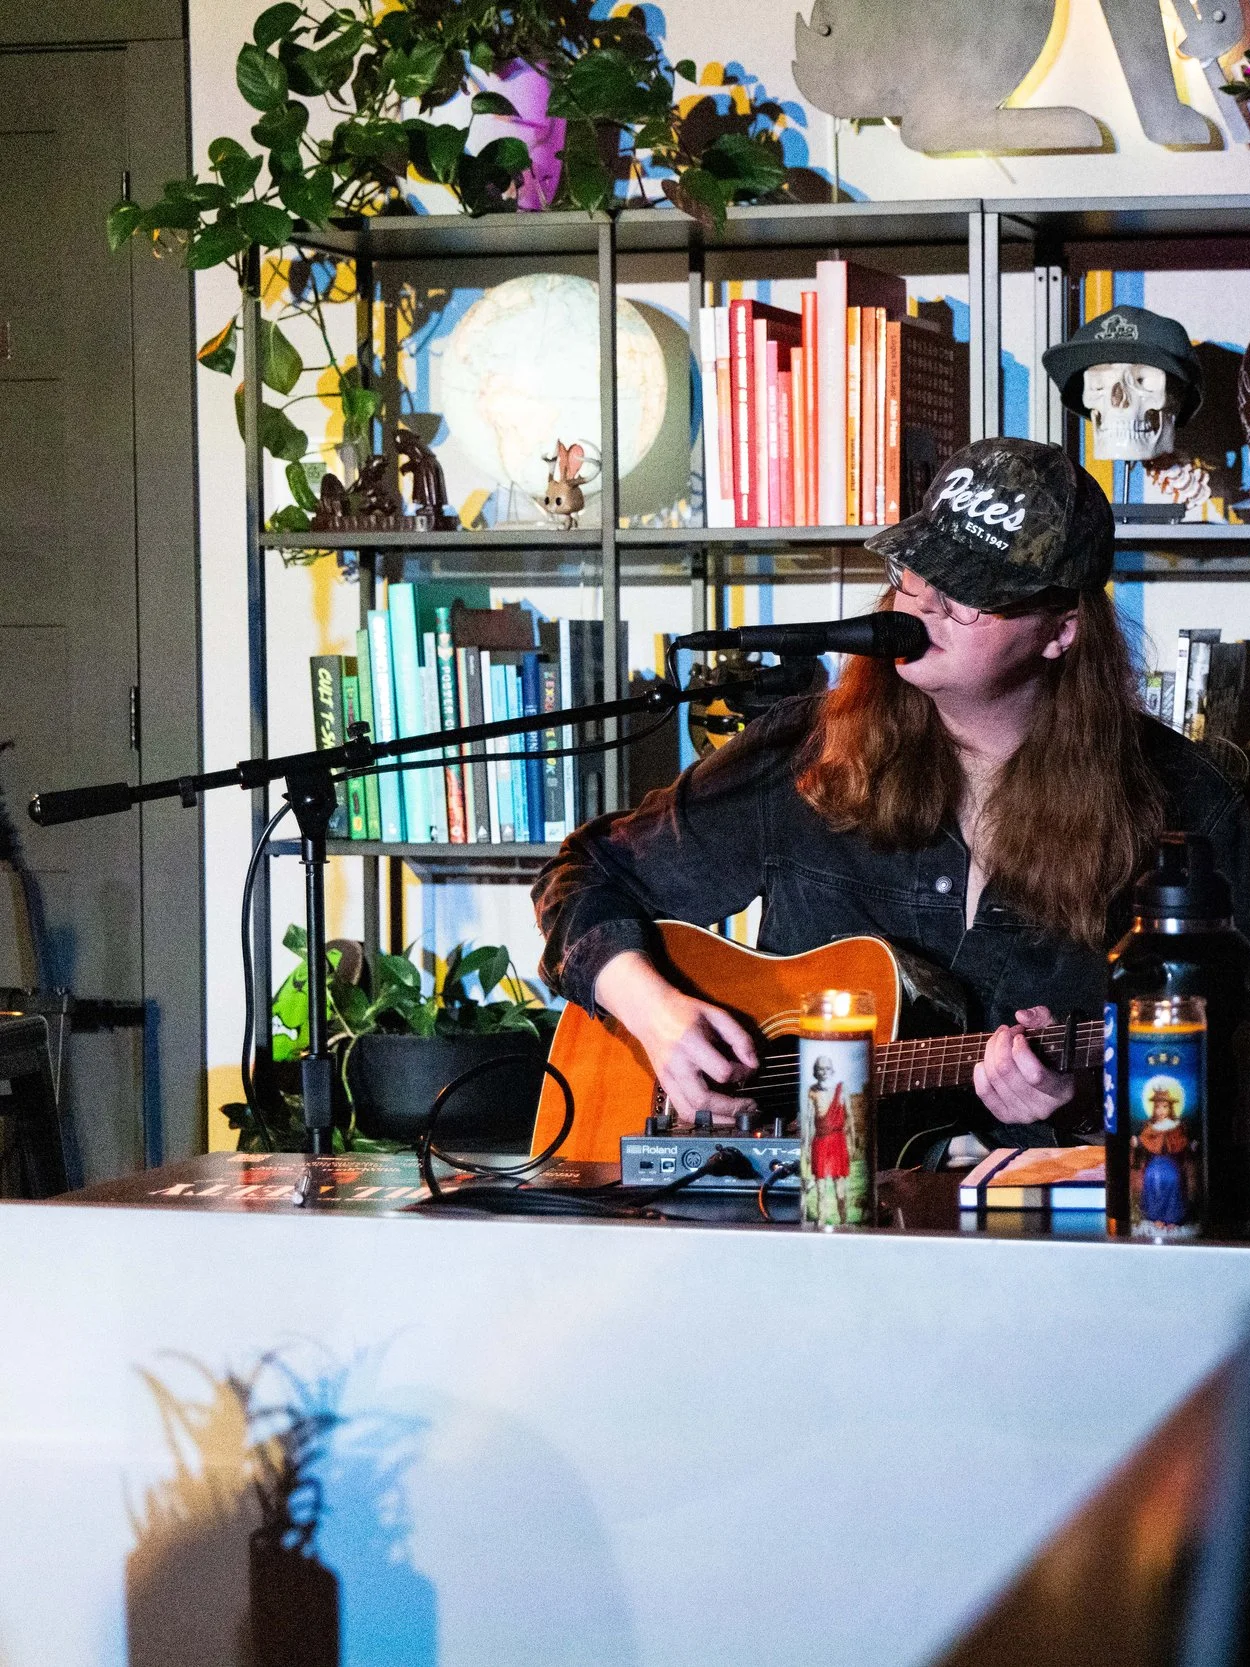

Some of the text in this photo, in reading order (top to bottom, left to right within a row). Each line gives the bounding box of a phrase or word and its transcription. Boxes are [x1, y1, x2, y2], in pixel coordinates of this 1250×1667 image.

[931, 467, 1026, 532] Pete's
[965, 520, 1009, 551] EST. 1947
[318, 667, 332, 705] CULT
[642, 1145, 801, 1156] Roland VT-4
